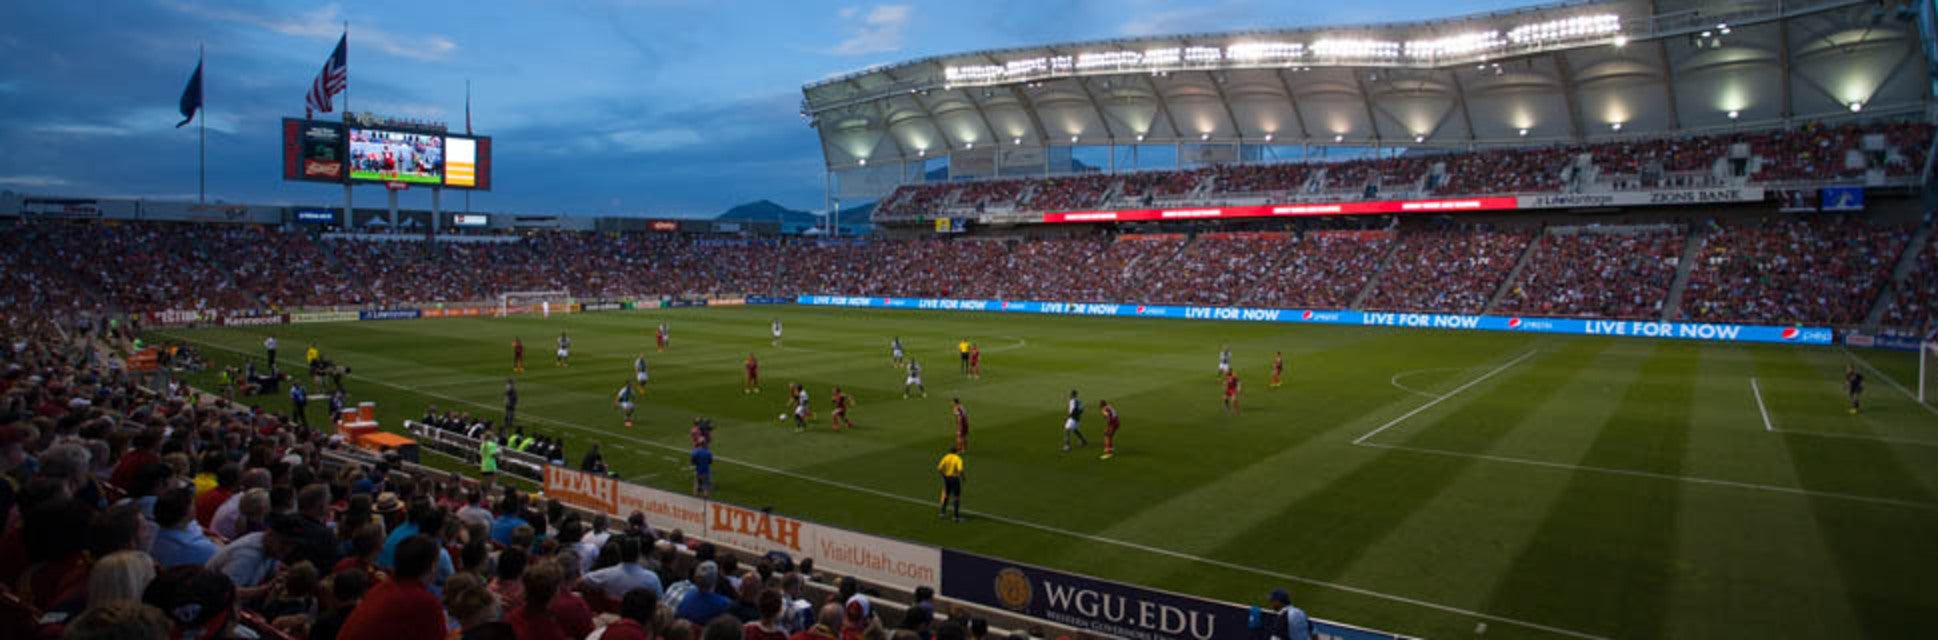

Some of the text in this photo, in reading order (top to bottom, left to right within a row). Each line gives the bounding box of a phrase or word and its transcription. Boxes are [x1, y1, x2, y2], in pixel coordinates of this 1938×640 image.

[1650, 190, 1740, 203] ZIONS BANK
[813, 296, 829, 304] LIVE
[847, 297, 871, 306] NOW
[919, 299, 987, 310] LIVE FOR NOW
[1041, 303, 1063, 313] LIVE
[1088, 304, 1120, 315] NOW
[1185, 307, 1280, 321] LIVE FOR NOW
[1363, 313, 1480, 329] LIVE FOR NOW
[1585, 320, 1741, 339] LIVE FOR NOW
[549, 466, 613, 504] UTAH
[712, 504, 801, 551] UTAH
[820, 540, 935, 582] VisitUtah.com
[1044, 580, 1216, 640] WGU.EDU
